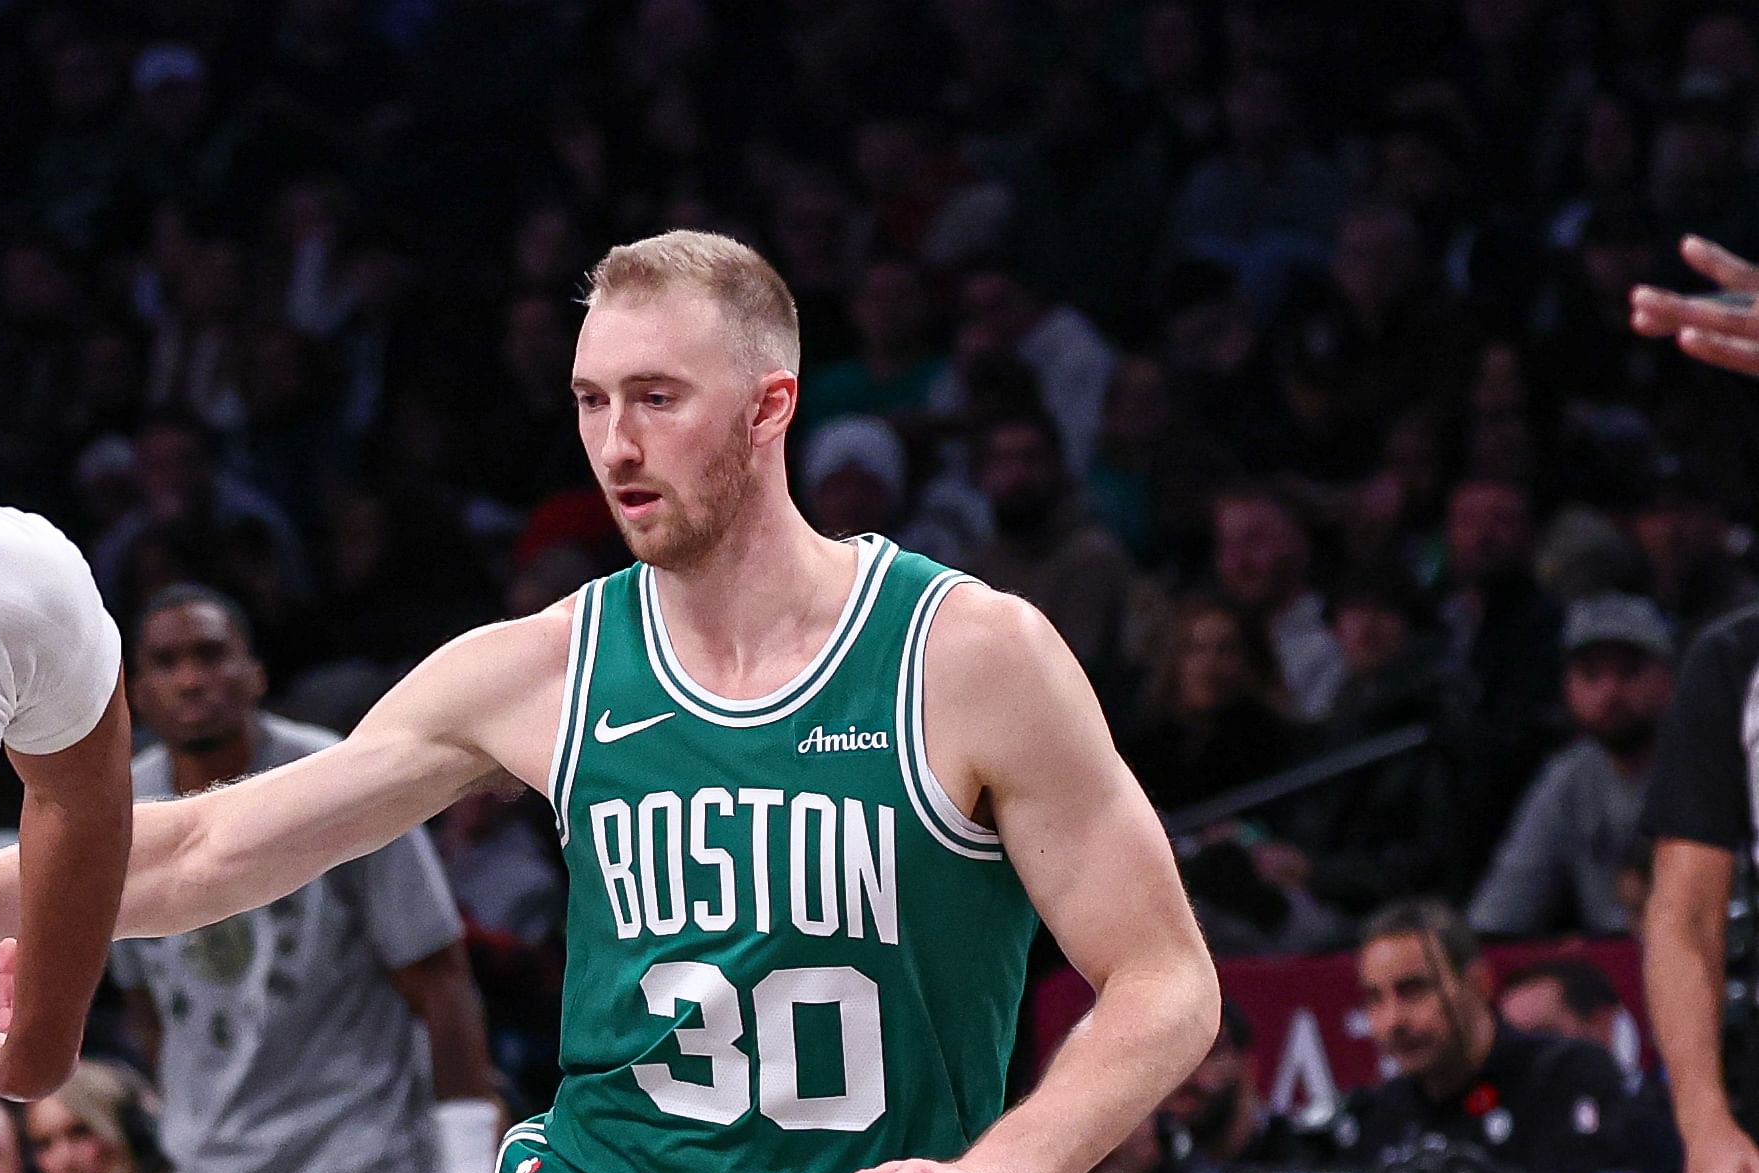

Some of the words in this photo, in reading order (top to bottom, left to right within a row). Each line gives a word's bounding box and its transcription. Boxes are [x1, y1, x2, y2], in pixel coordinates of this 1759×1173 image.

[797, 725, 889, 754] Amica
[590, 787, 899, 945] BOSTON
[632, 961, 887, 1133] 30
